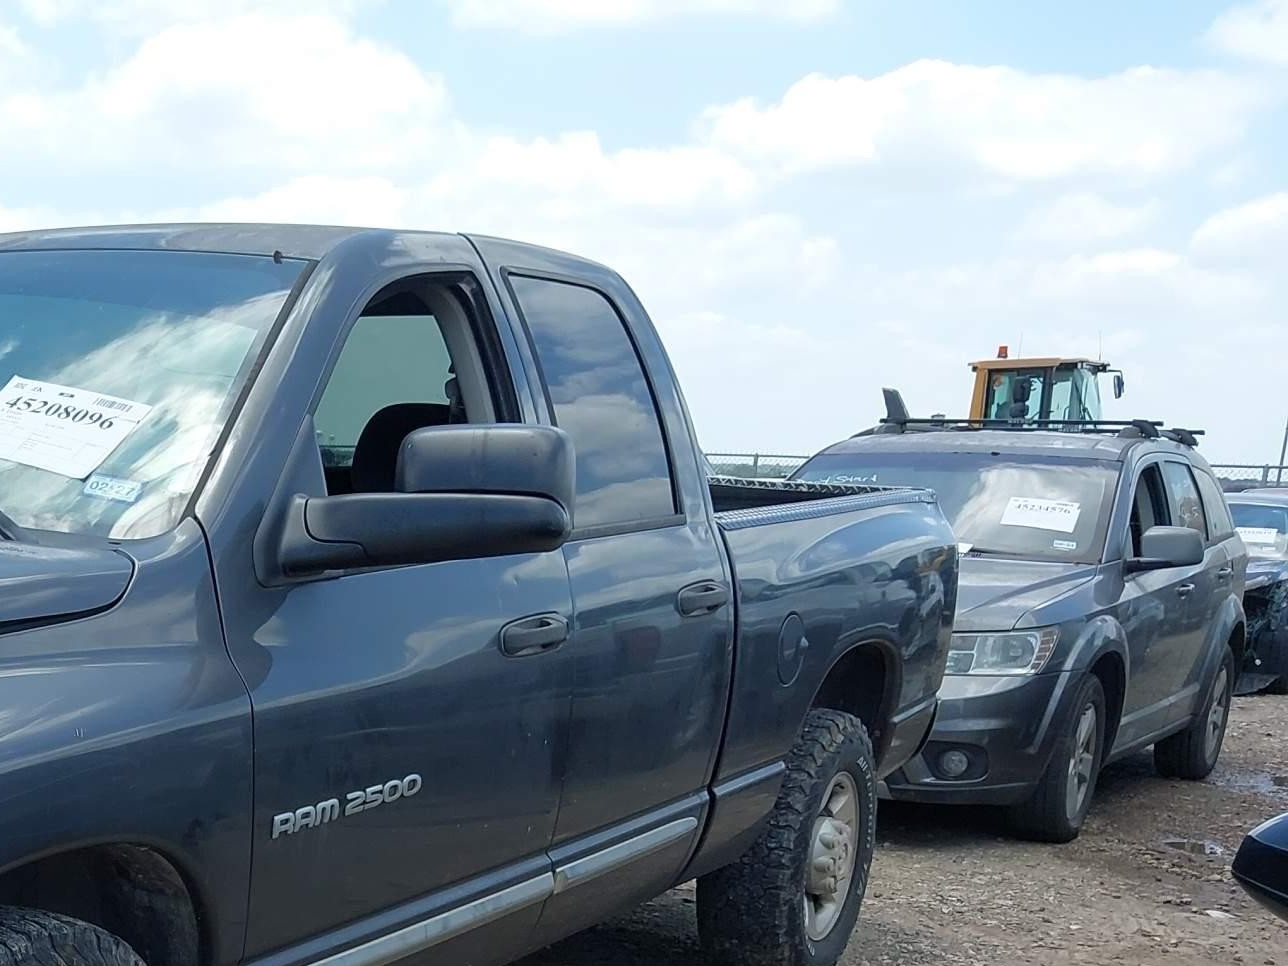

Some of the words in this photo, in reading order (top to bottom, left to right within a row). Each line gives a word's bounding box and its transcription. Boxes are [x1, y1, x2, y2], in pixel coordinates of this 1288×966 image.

[5, 395, 117, 430] 45208096
[272, 798, 340, 839] RAM
[344, 773, 423, 817] 2500
